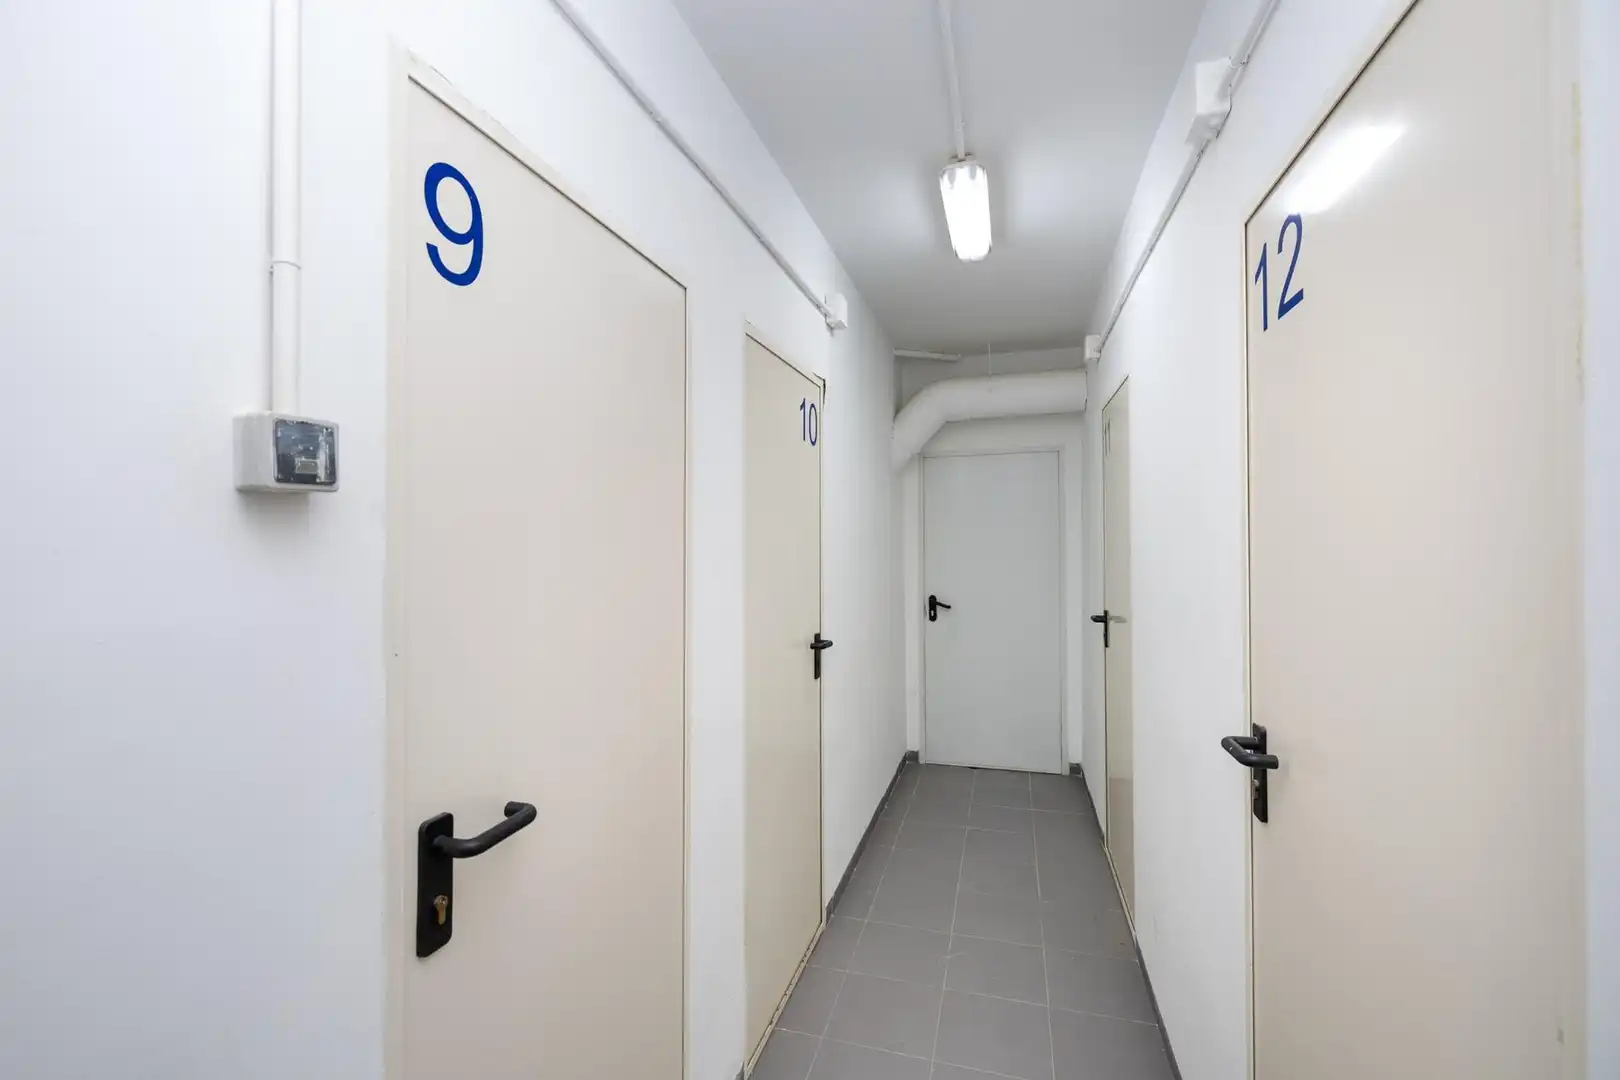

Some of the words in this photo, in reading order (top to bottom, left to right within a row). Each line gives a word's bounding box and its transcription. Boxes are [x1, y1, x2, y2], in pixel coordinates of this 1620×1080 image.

[424, 161, 484, 287] 9
[1254, 213, 1304, 332] 12
[799, 397, 818, 447] 10
